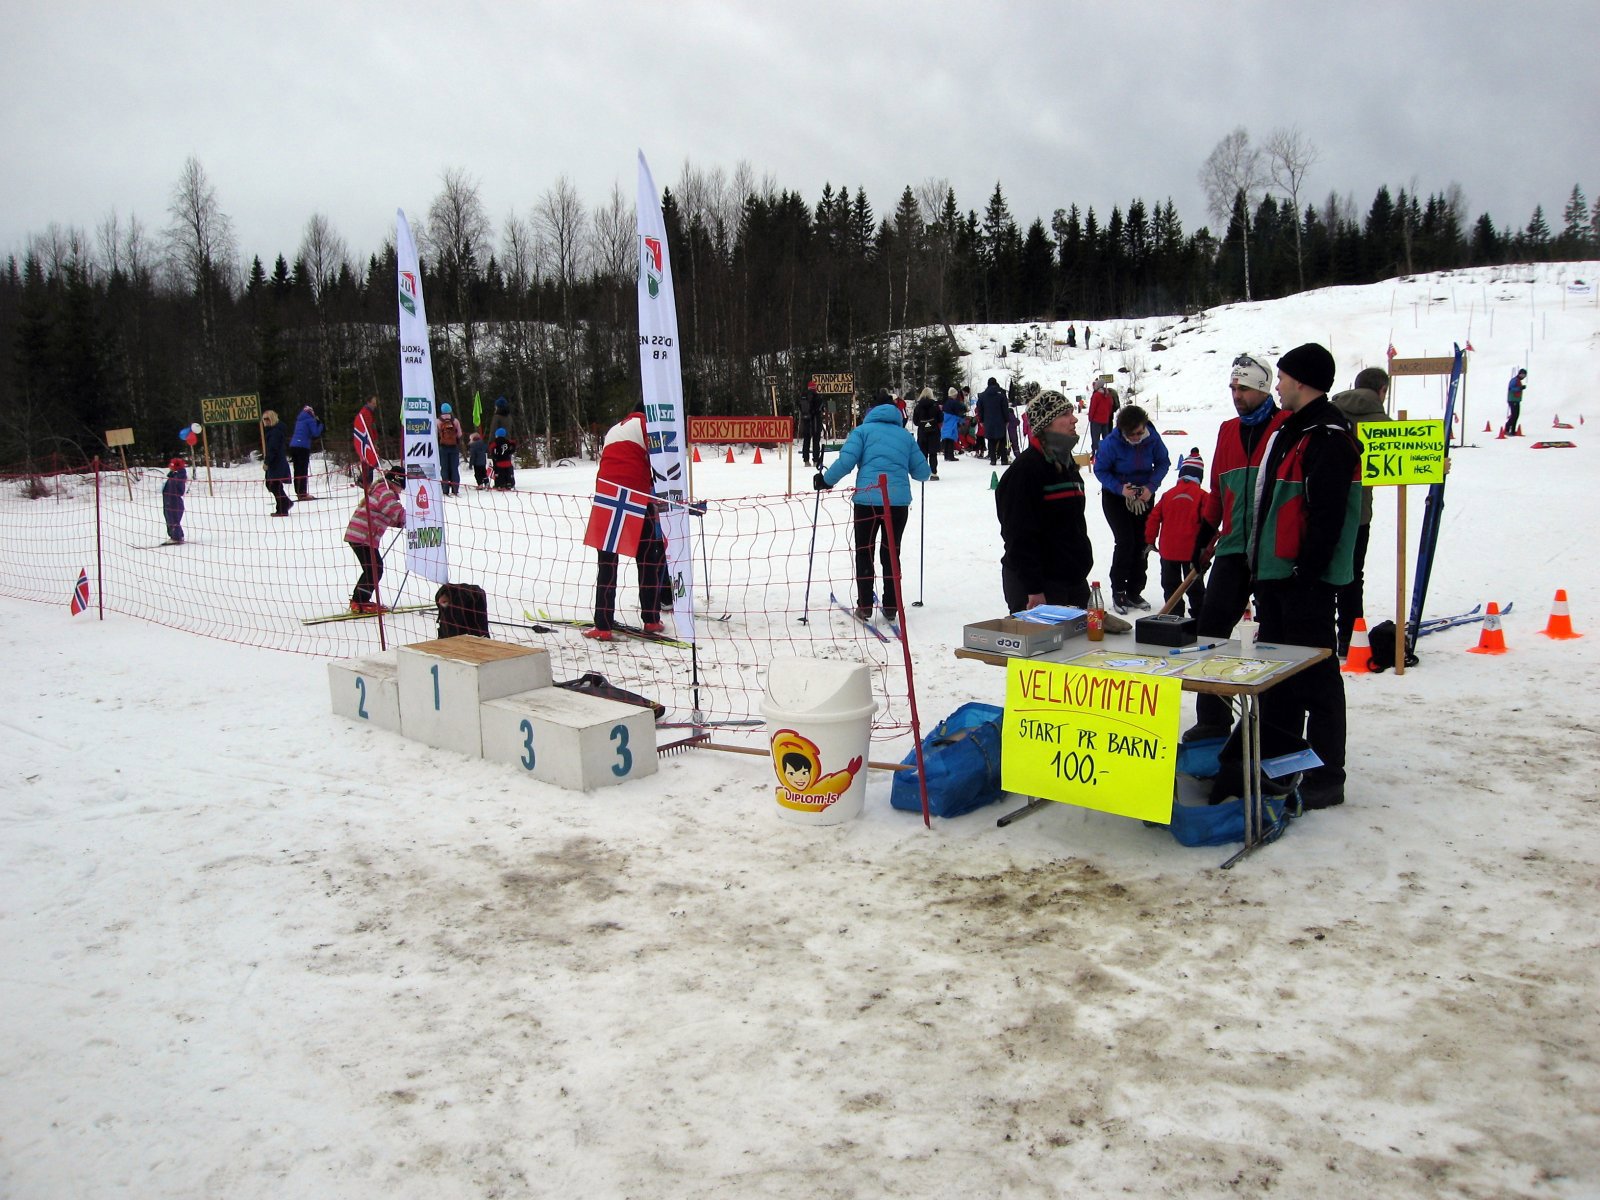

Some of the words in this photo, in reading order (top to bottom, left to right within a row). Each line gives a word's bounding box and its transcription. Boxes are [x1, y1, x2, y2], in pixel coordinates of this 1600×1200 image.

[813, 374, 853, 383] STANDPLASS
[817, 383, 853, 393] ORTLØYPE
[203, 396, 256, 410] STANDPLASS
[233, 407, 257, 420] LØYPE
[692, 421, 789, 438] SKISKYTTERARENA
[1362, 425, 1437, 440] VENNLIGST
[1364, 454, 1403, 479] SKI
[1414, 464, 1434, 475] HER
[997, 637, 1021, 649] DCP
[430, 663, 440, 711] 1
[1019, 669, 1159, 717] VELKOMMEN
[355, 676, 369, 720] 2
[519, 718, 536, 772] 3
[1019, 718, 1070, 744] START
[1077, 729, 1098, 750] PR
[1107, 732, 1167, 760] BARN:
[609, 723, 633, 777] 3
[1050, 750, 1109, 786] 100,-
